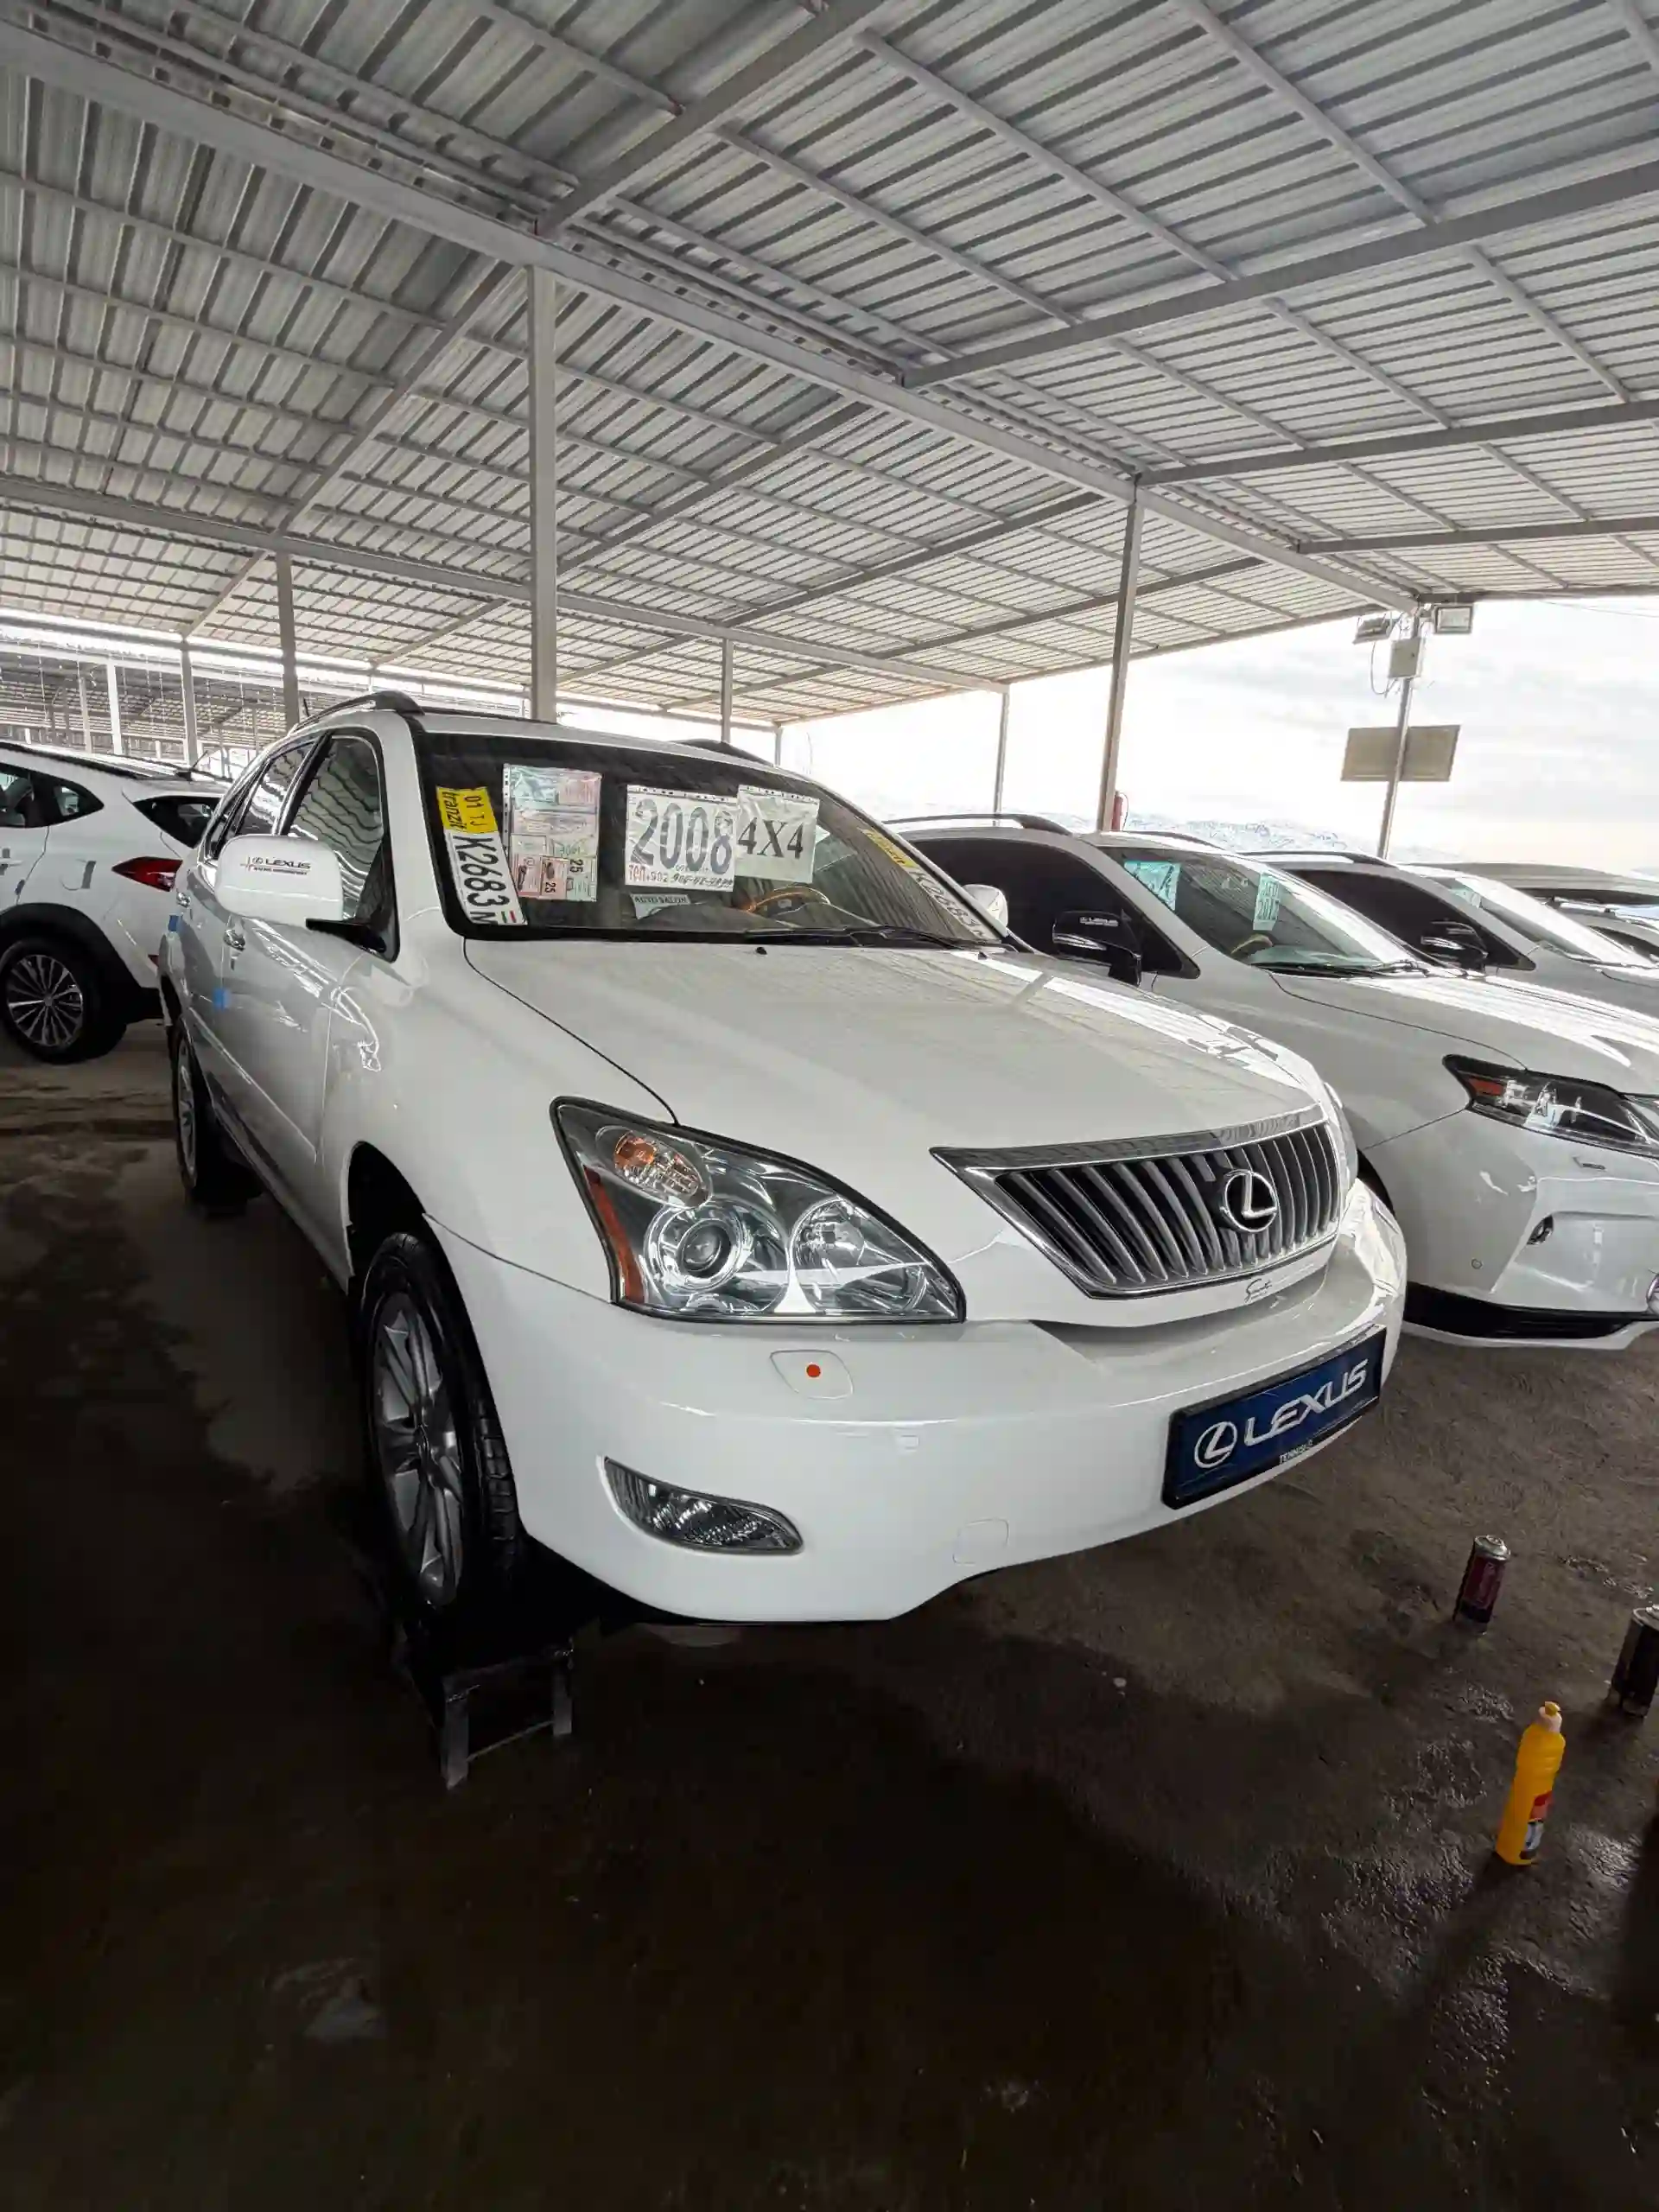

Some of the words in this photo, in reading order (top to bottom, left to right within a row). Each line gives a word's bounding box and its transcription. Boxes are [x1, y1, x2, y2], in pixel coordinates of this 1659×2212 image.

[442, 791, 467, 830] tranzit
[464, 795, 484, 808] 01
[470, 816, 487, 827] TJ
[630, 798, 734, 874] 2008
[265, 858, 312, 869] LEXUS
[453, 836, 510, 907] K2683
[1243, 1358, 1369, 1446] LEXUS
